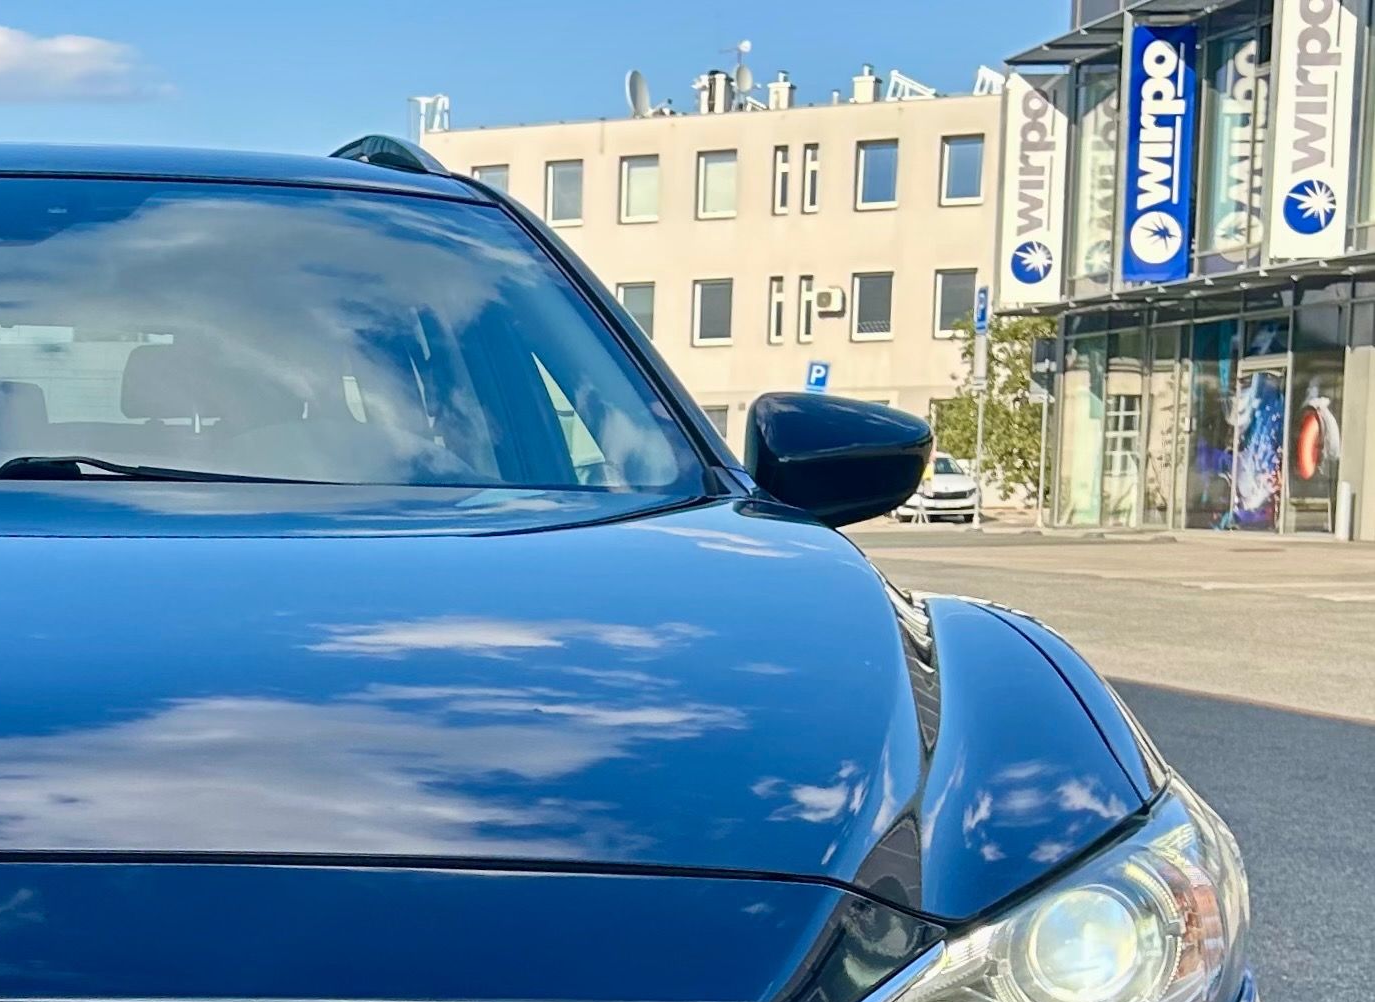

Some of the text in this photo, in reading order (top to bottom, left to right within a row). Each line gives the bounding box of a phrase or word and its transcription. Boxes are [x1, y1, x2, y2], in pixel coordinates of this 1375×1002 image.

[1017, 88, 1056, 237] wirpo
[1137, 40, 1185, 210] wirpo
[1291, 0, 1342, 174] wirpo
[810, 365, 826, 385] P
